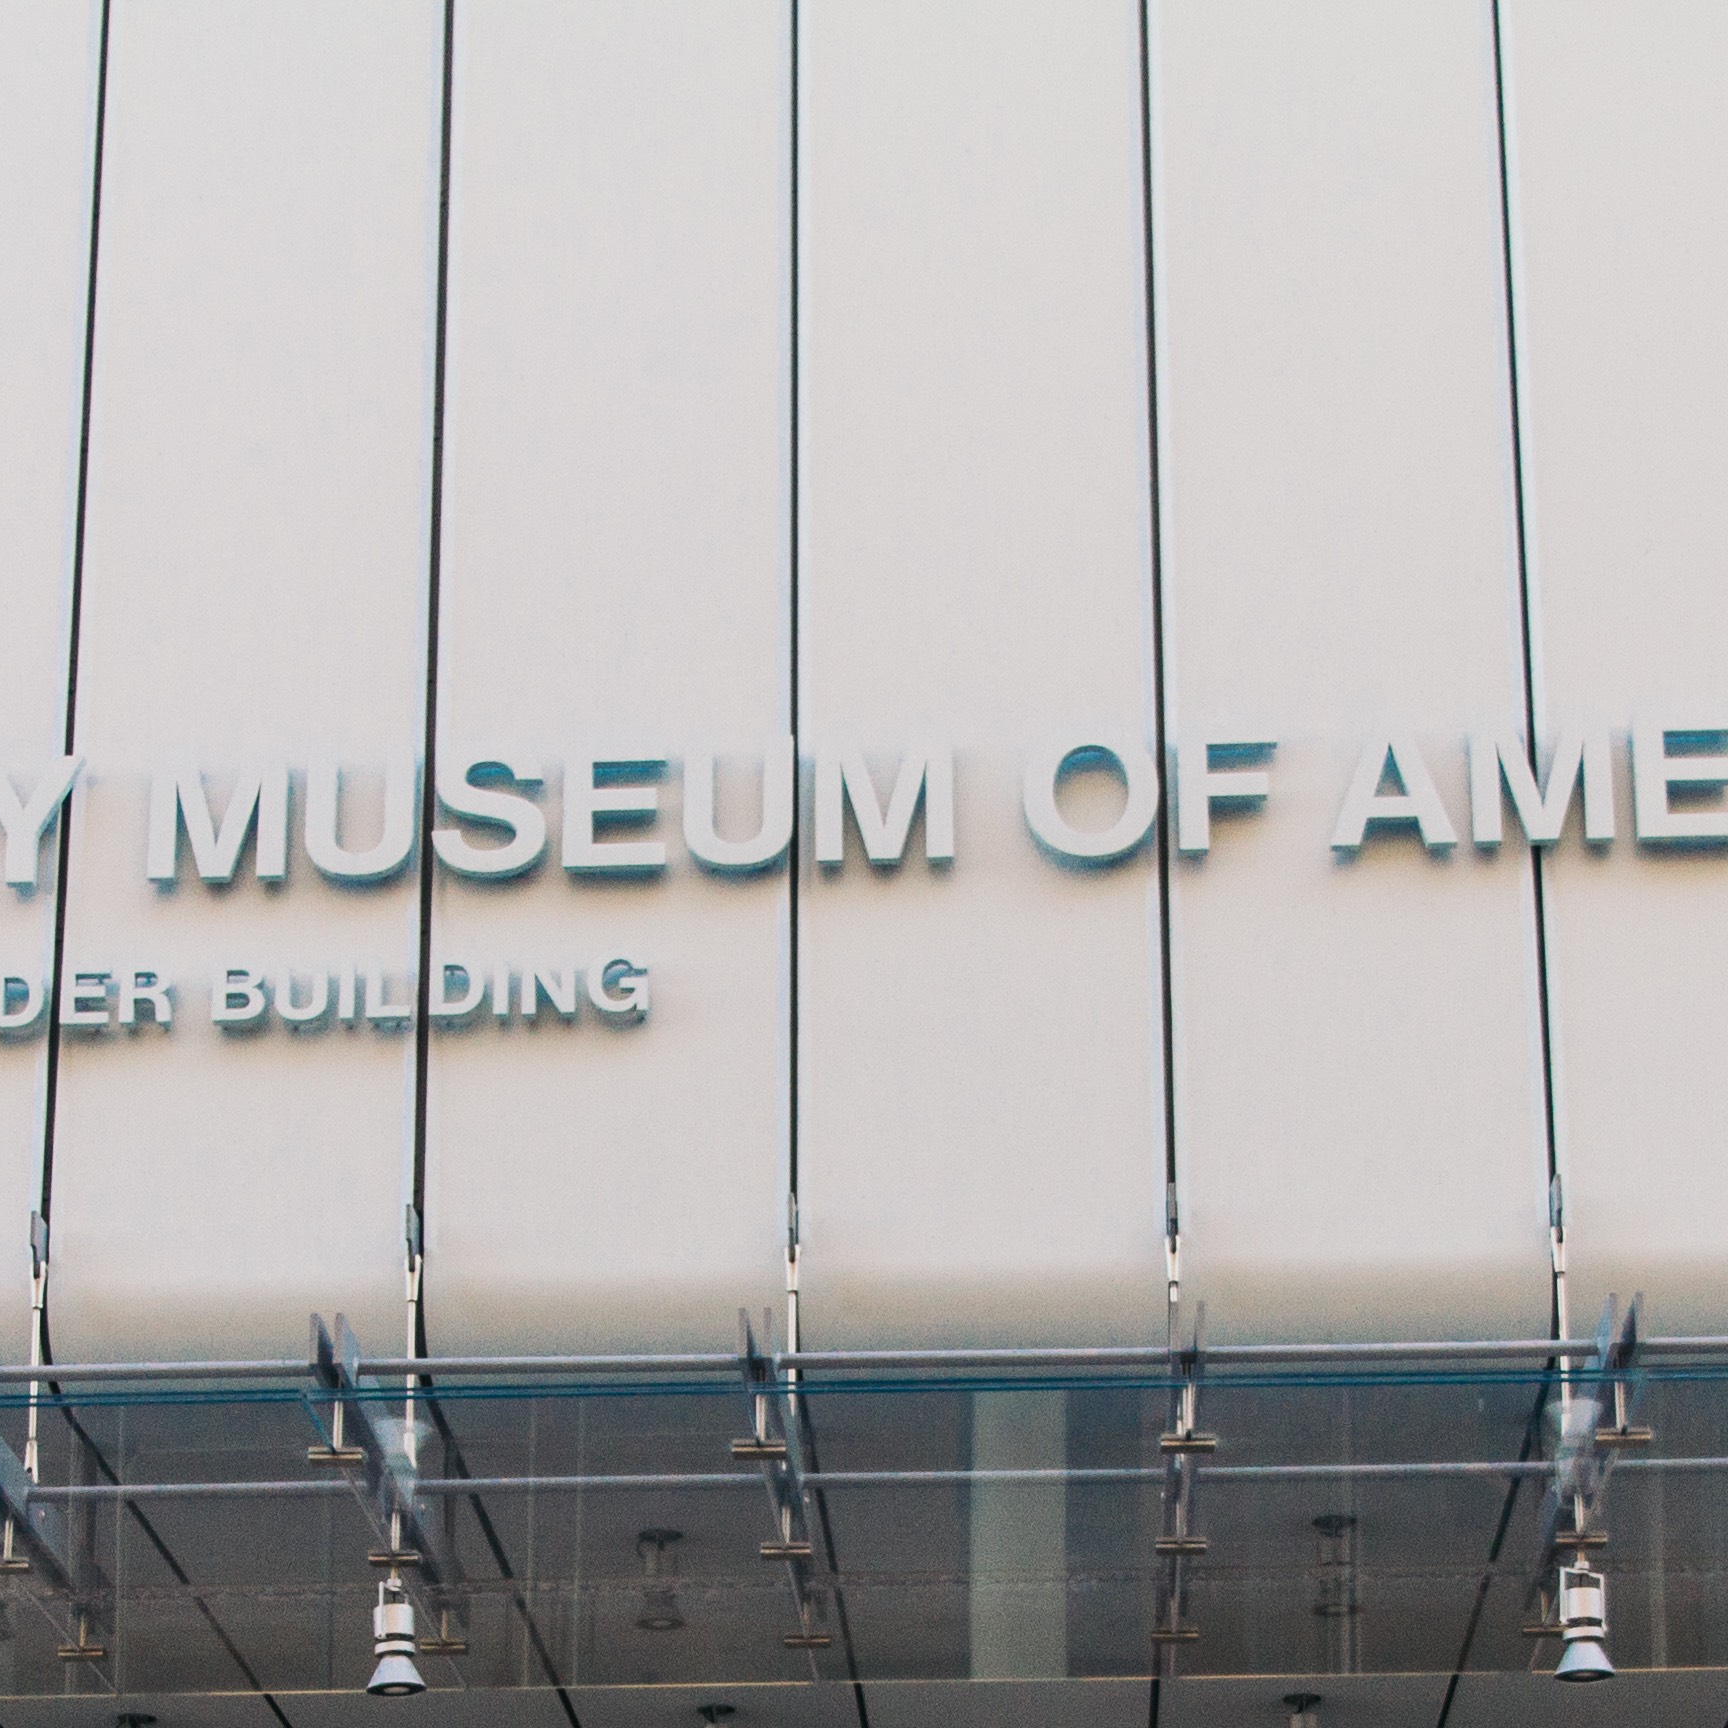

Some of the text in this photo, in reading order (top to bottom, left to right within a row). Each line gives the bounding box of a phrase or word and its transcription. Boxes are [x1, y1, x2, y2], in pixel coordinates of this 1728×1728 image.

[144, 734, 958, 890] MUSEUM
[1020, 738, 1278, 868] OF
[210, 956, 654, 1028] BUILDING
